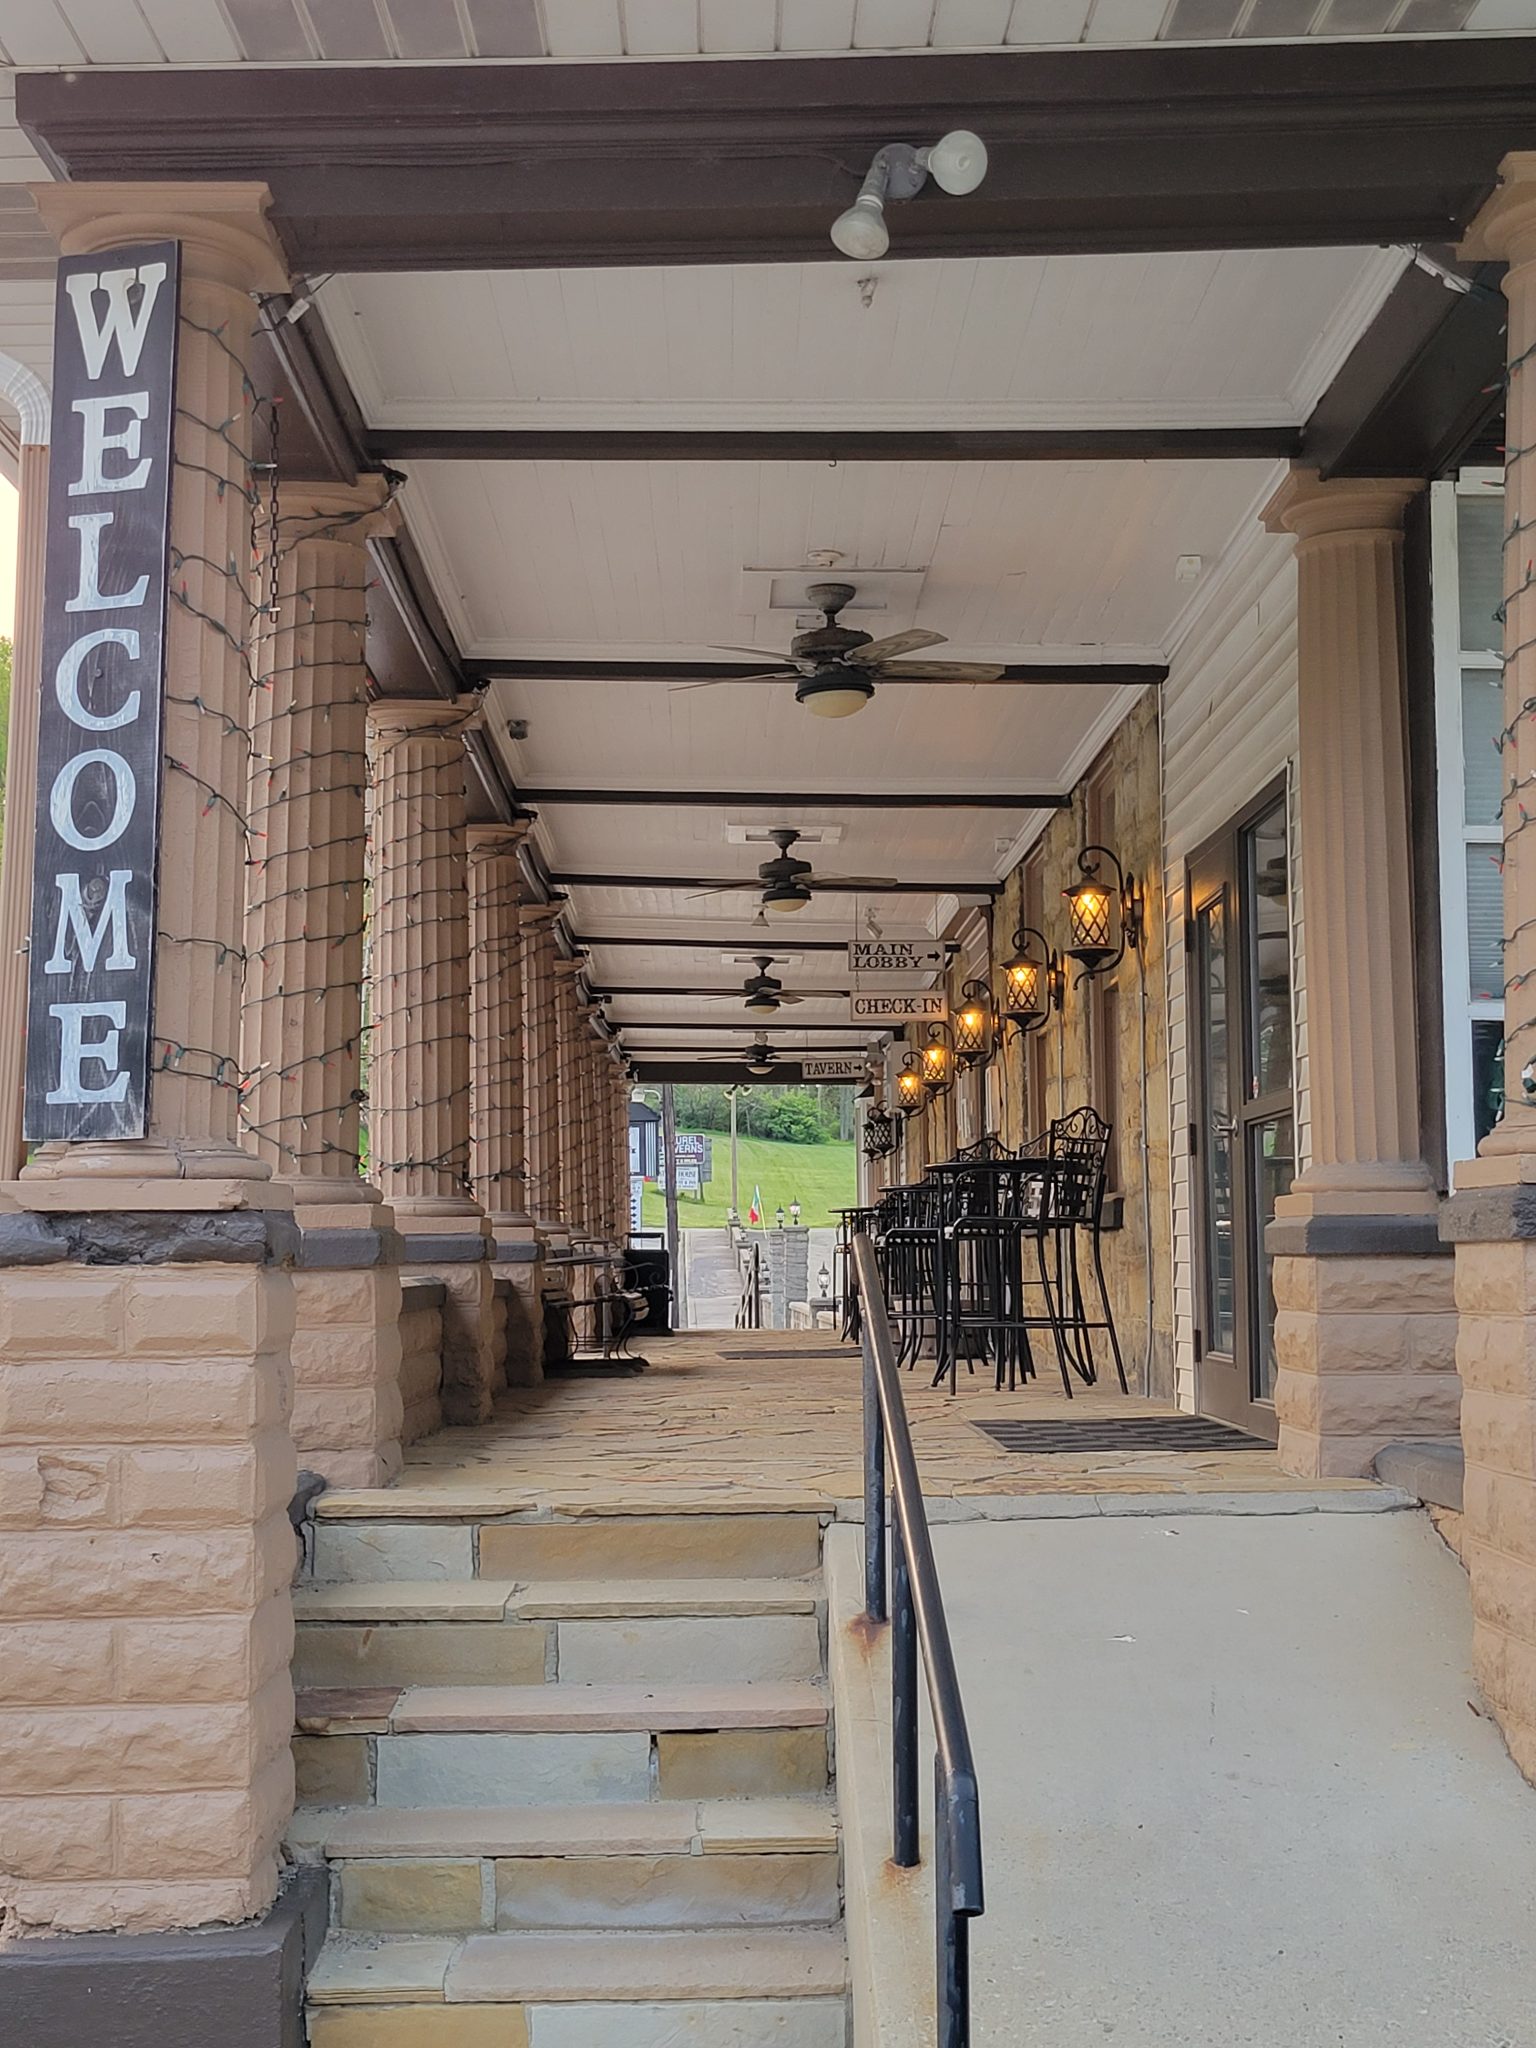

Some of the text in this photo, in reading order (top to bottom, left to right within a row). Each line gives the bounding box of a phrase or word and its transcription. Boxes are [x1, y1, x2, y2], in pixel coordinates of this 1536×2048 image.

[44, 262, 167, 1105] WELCOME
[853, 943, 915, 955] MAIN
[853, 956, 924, 968] LOBBY
[854, 997, 944, 1014] CHECK-IN
[805, 1061, 853, 1075] TAVERN
[675, 1136, 700, 1145] UREL
[674, 1144, 703, 1153] VERNS
